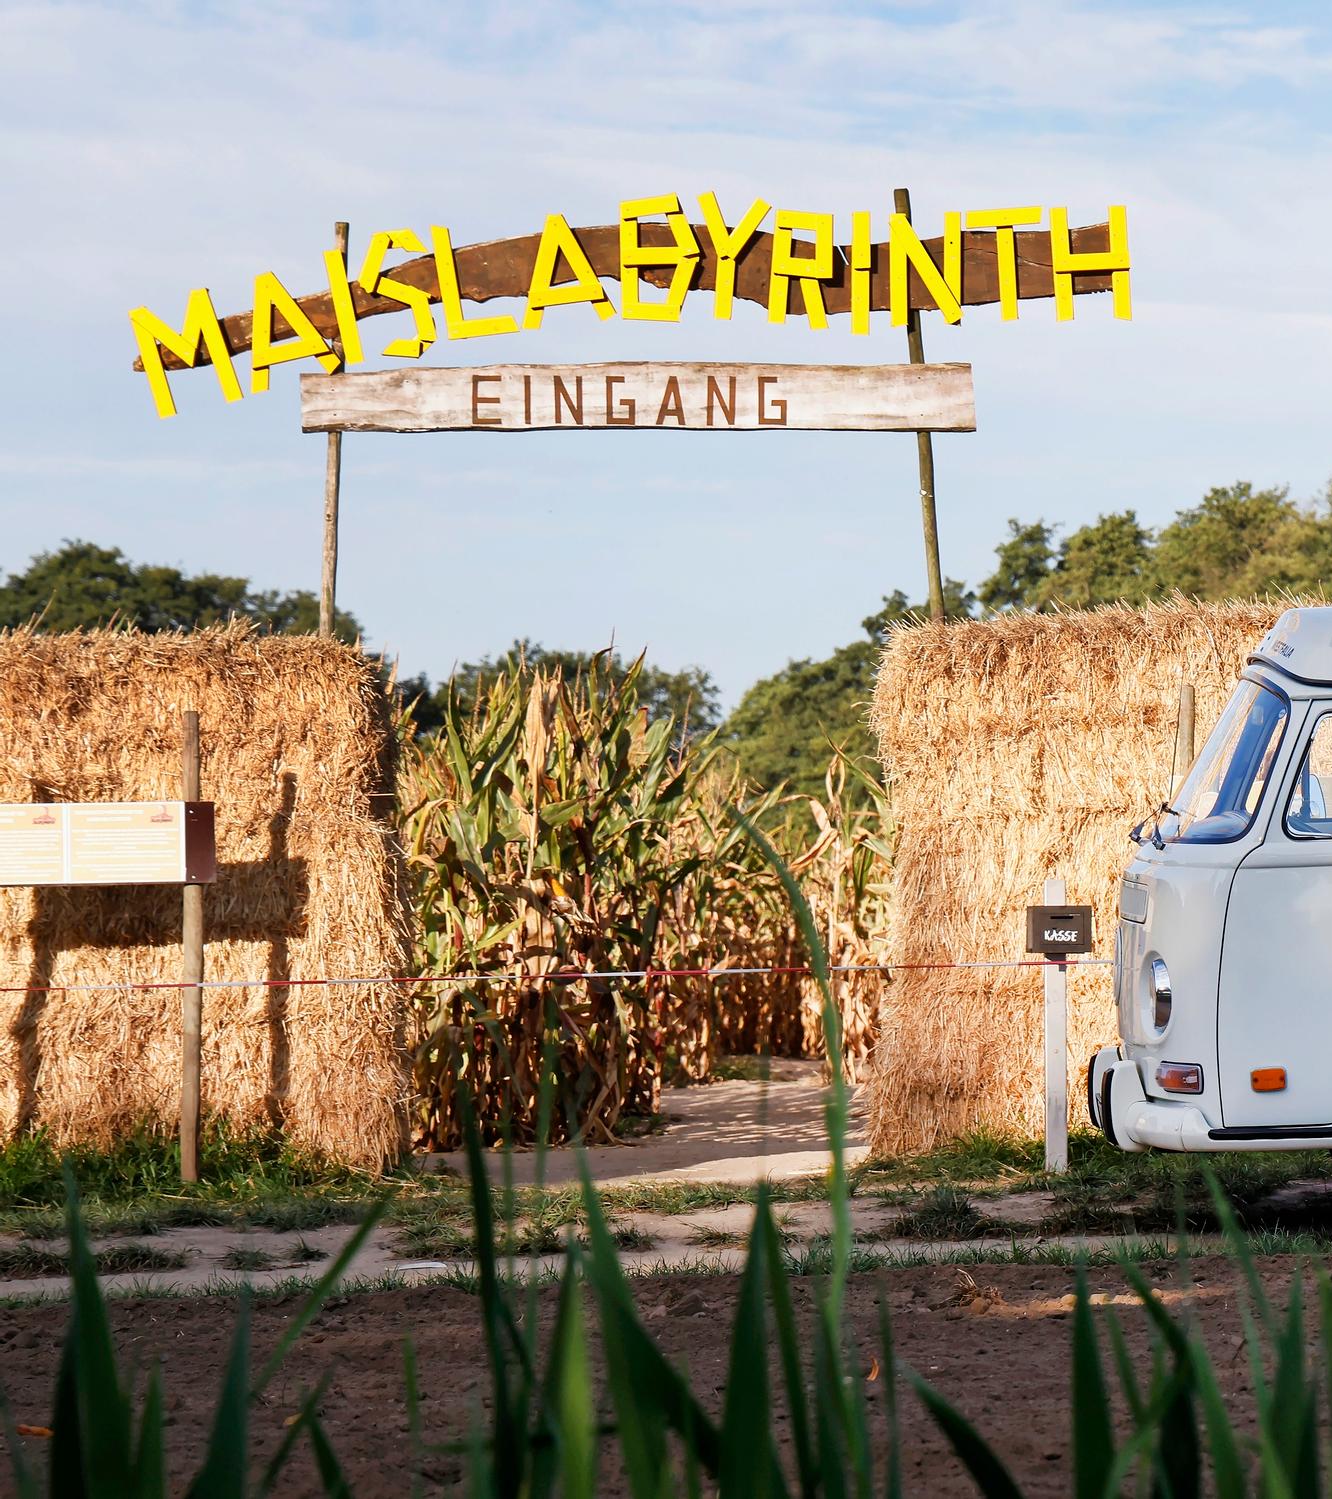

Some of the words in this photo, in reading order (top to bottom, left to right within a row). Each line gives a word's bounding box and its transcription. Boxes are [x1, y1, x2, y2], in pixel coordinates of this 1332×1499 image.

[129, 191, 1132, 417] MAISLABYRINTH
[471, 375, 788, 426] EINGANG
[1044, 929, 1078, 942] KASSE
